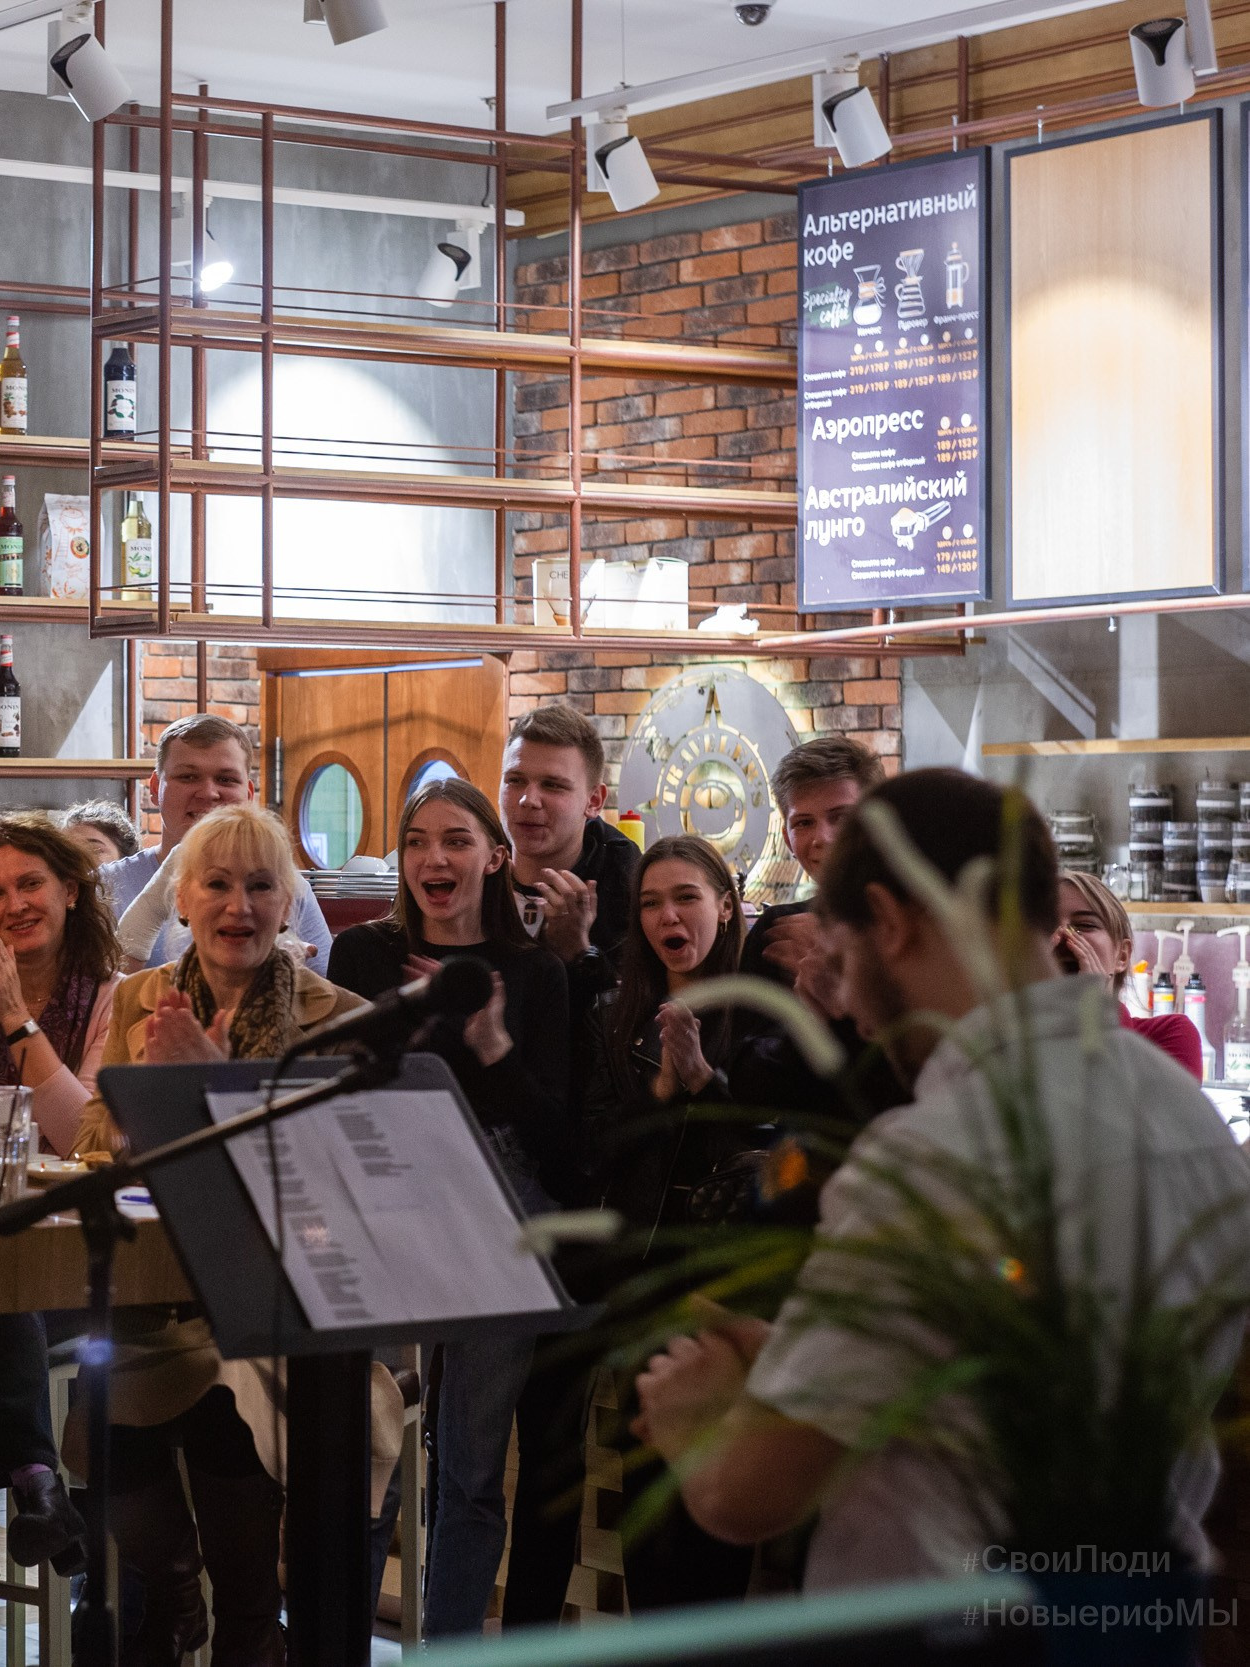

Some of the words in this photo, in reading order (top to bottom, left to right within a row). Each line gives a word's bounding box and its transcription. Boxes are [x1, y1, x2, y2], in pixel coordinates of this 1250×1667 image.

[803, 183, 977, 238] Альтернативный
[803, 239, 854, 268] кофе
[811, 409, 925, 444] Аэропресс
[805, 470, 968, 512] Австралийский
[805, 516, 866, 547] лунго
[549, 568, 589, 580] CHEEX
